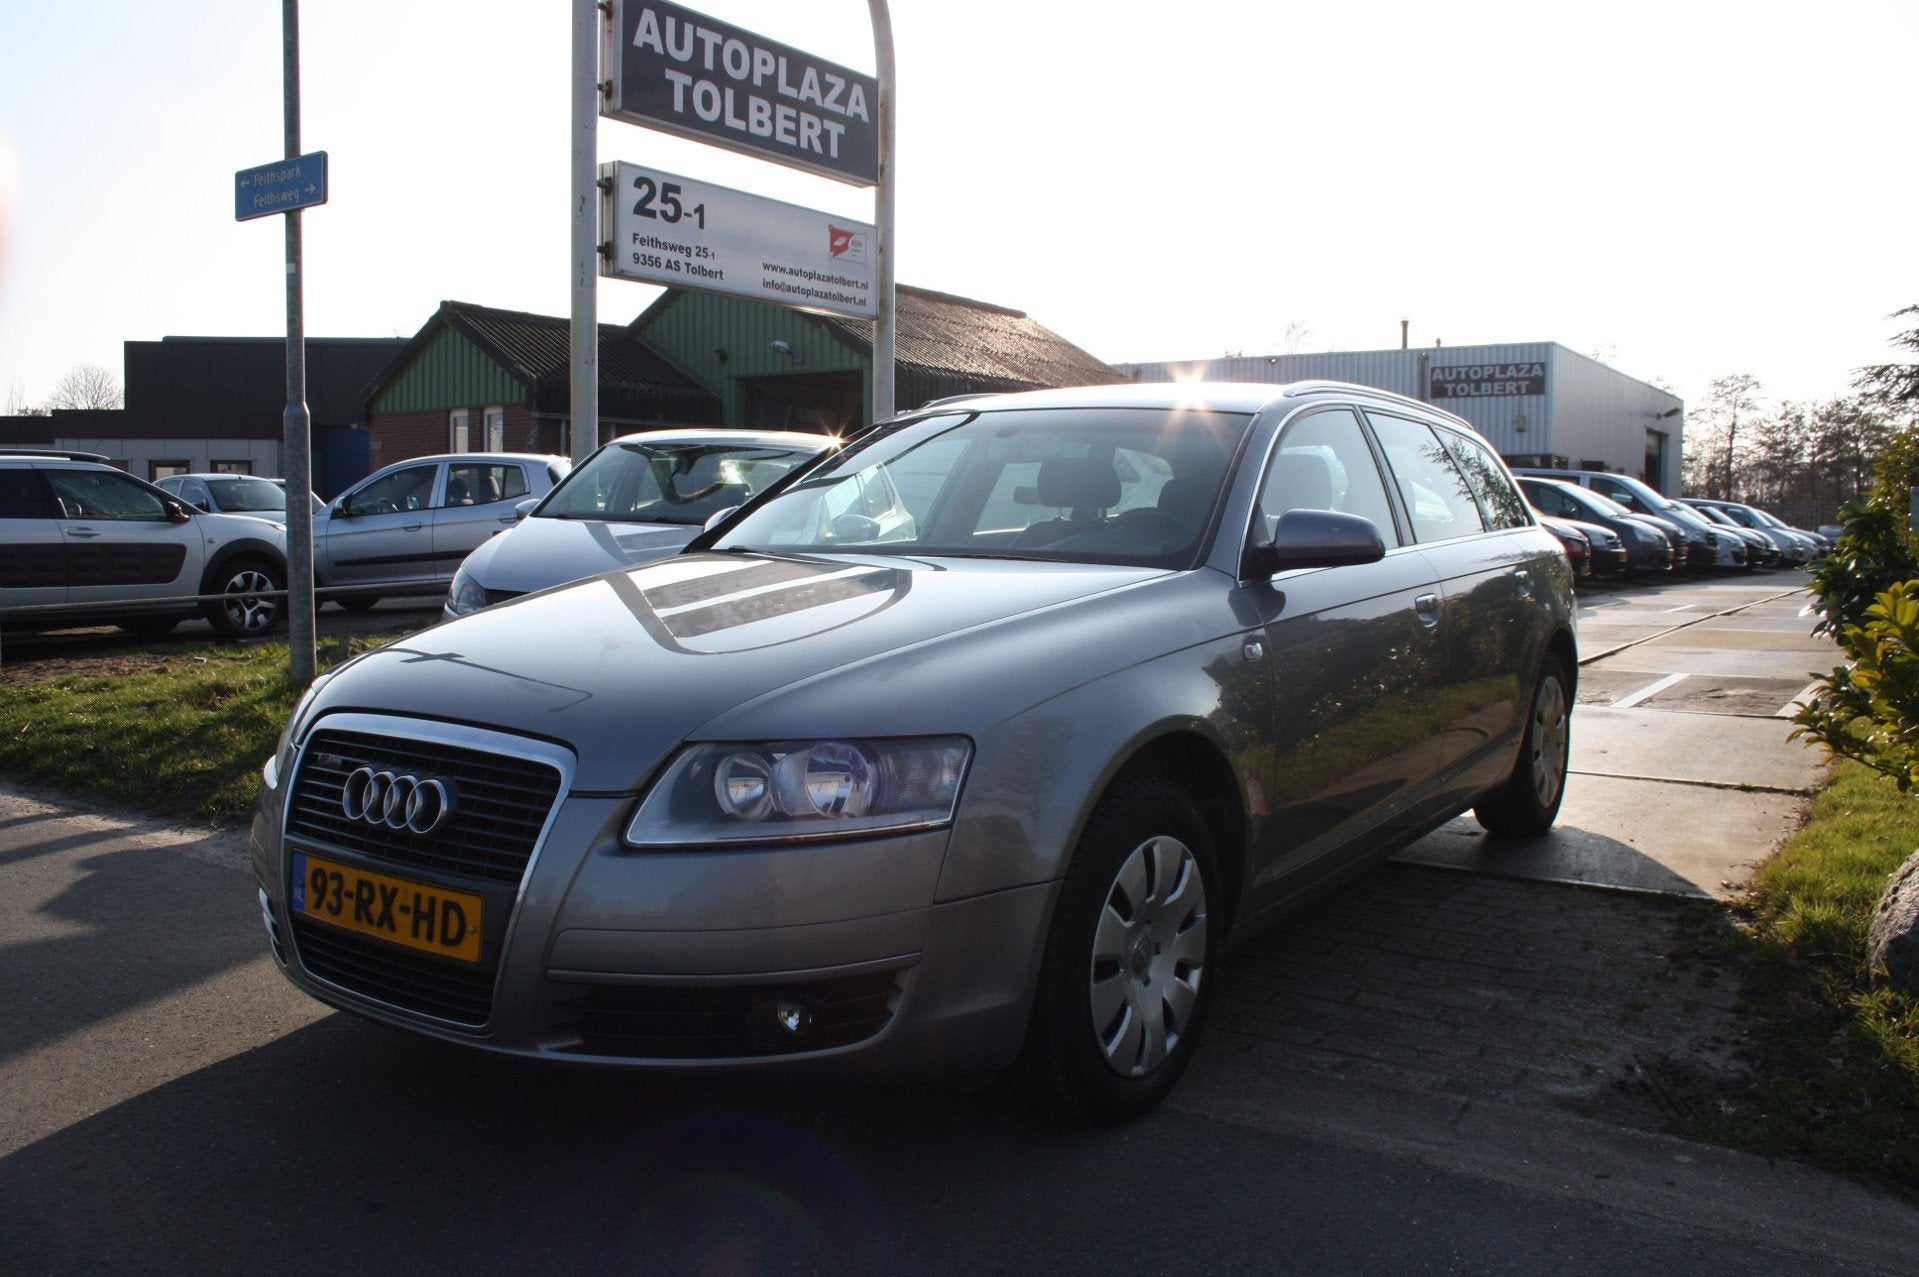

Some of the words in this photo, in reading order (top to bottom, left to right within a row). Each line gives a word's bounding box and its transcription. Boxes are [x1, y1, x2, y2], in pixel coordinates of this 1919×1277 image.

[632, 8, 869, 123] AUTOPLAZA
[664, 68, 845, 158] TOLBERT
[254, 164, 300, 187] Feithspark
[254, 189, 299, 207] Feithsweg
[633, 176, 705, 230] 25-1
[633, 233, 692, 258] Feithsweg
[633, 252, 661, 268] 9356
[665, 259, 681, 272] AS
[685, 262, 723, 280] Tolbert
[762, 262, 869, 290] www.autoplazatolbert.nl
[762, 278, 867, 306] info@autoplazatolbert.nl
[1432, 364, 1543, 380] AUTOPLAZA
[1444, 381, 1530, 396] TOLBERT
[310, 867, 467, 947] 93-RX-HD
